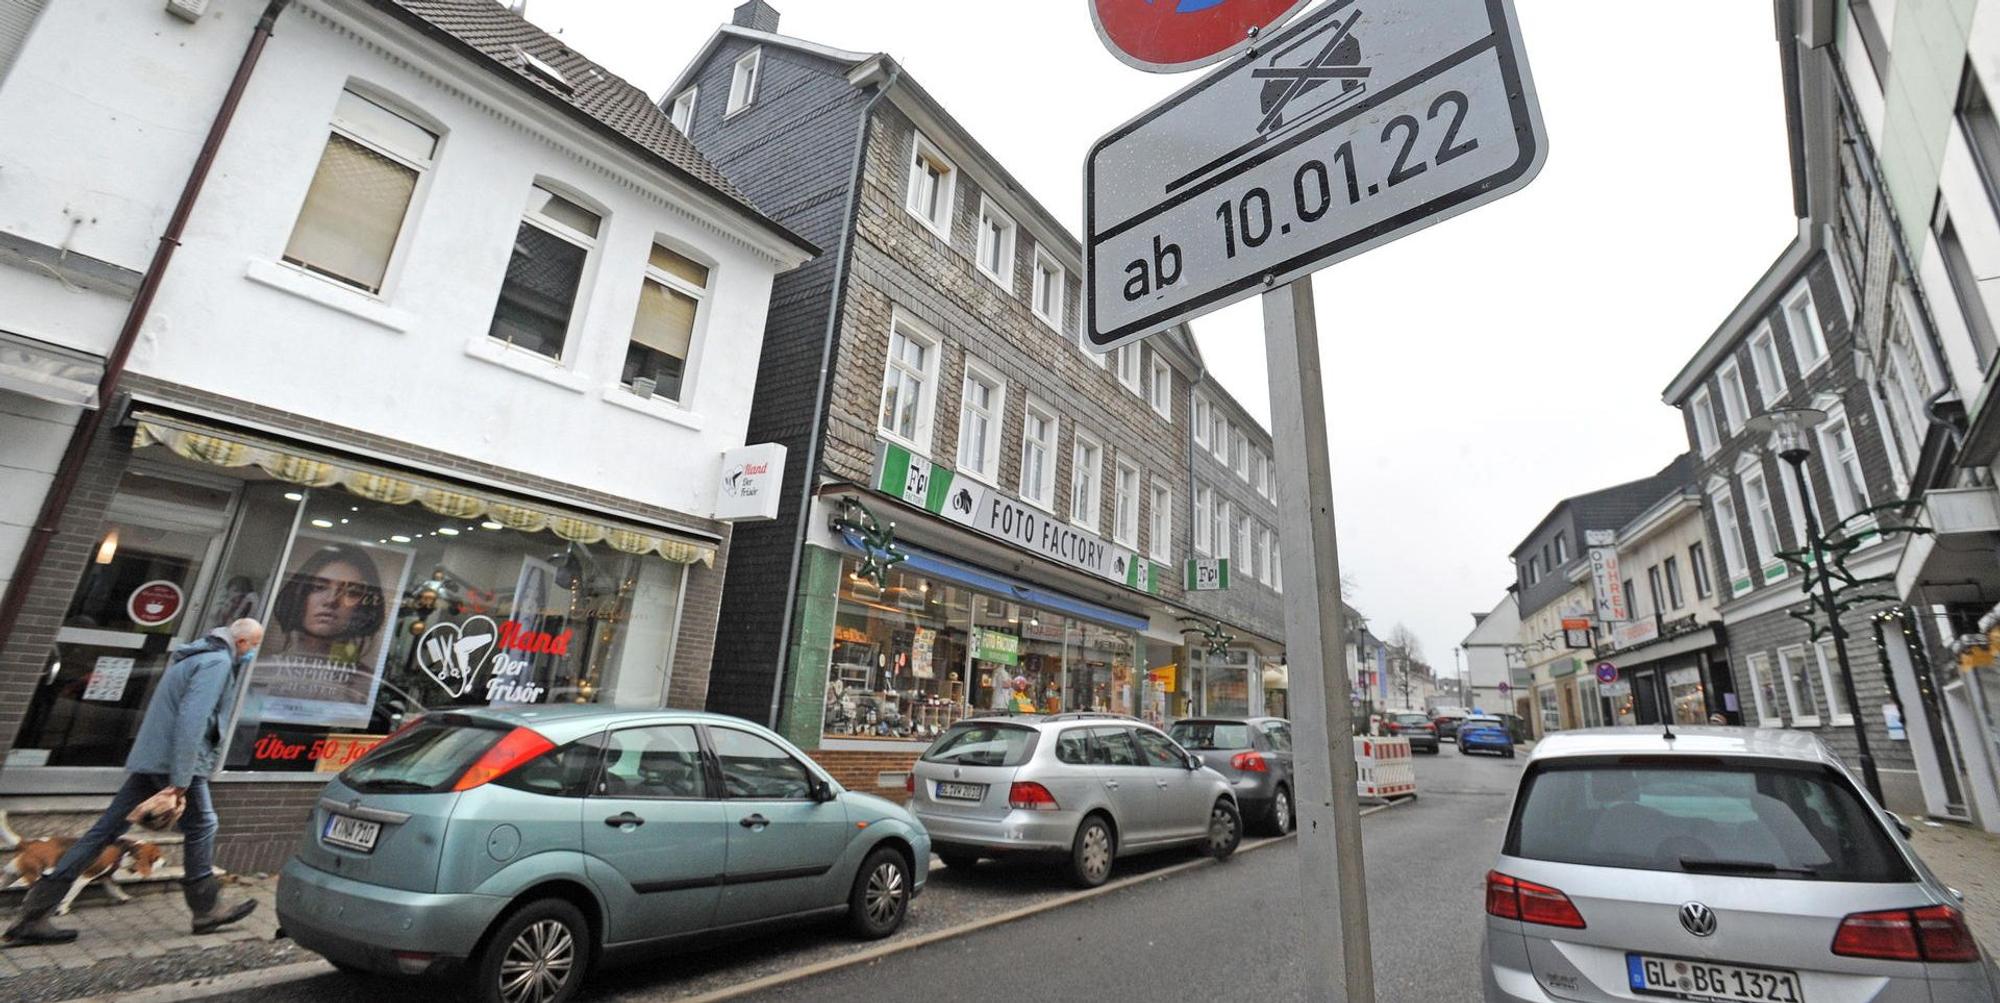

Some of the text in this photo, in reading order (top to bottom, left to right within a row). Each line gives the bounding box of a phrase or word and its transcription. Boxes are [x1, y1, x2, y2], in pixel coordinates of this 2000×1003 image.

[1122, 90, 1479, 302] ab 10.01.22
[991, 499, 1104, 571] FOTO FACTORY
[1592, 551, 1610, 610] OPTIK
[1606, 558, 1626, 618] UHREN
[499, 620, 574, 656] Nand
[491, 653, 528, 675] Der
[486, 678, 544, 703] Frisör
[255, 731, 306, 760] Über
[308, 740, 338, 759] 50
[1645, 961, 1676, 987] GL
[1692, 965, 1726, 994] BG
[1731, 970, 1798, 1003] 1321
